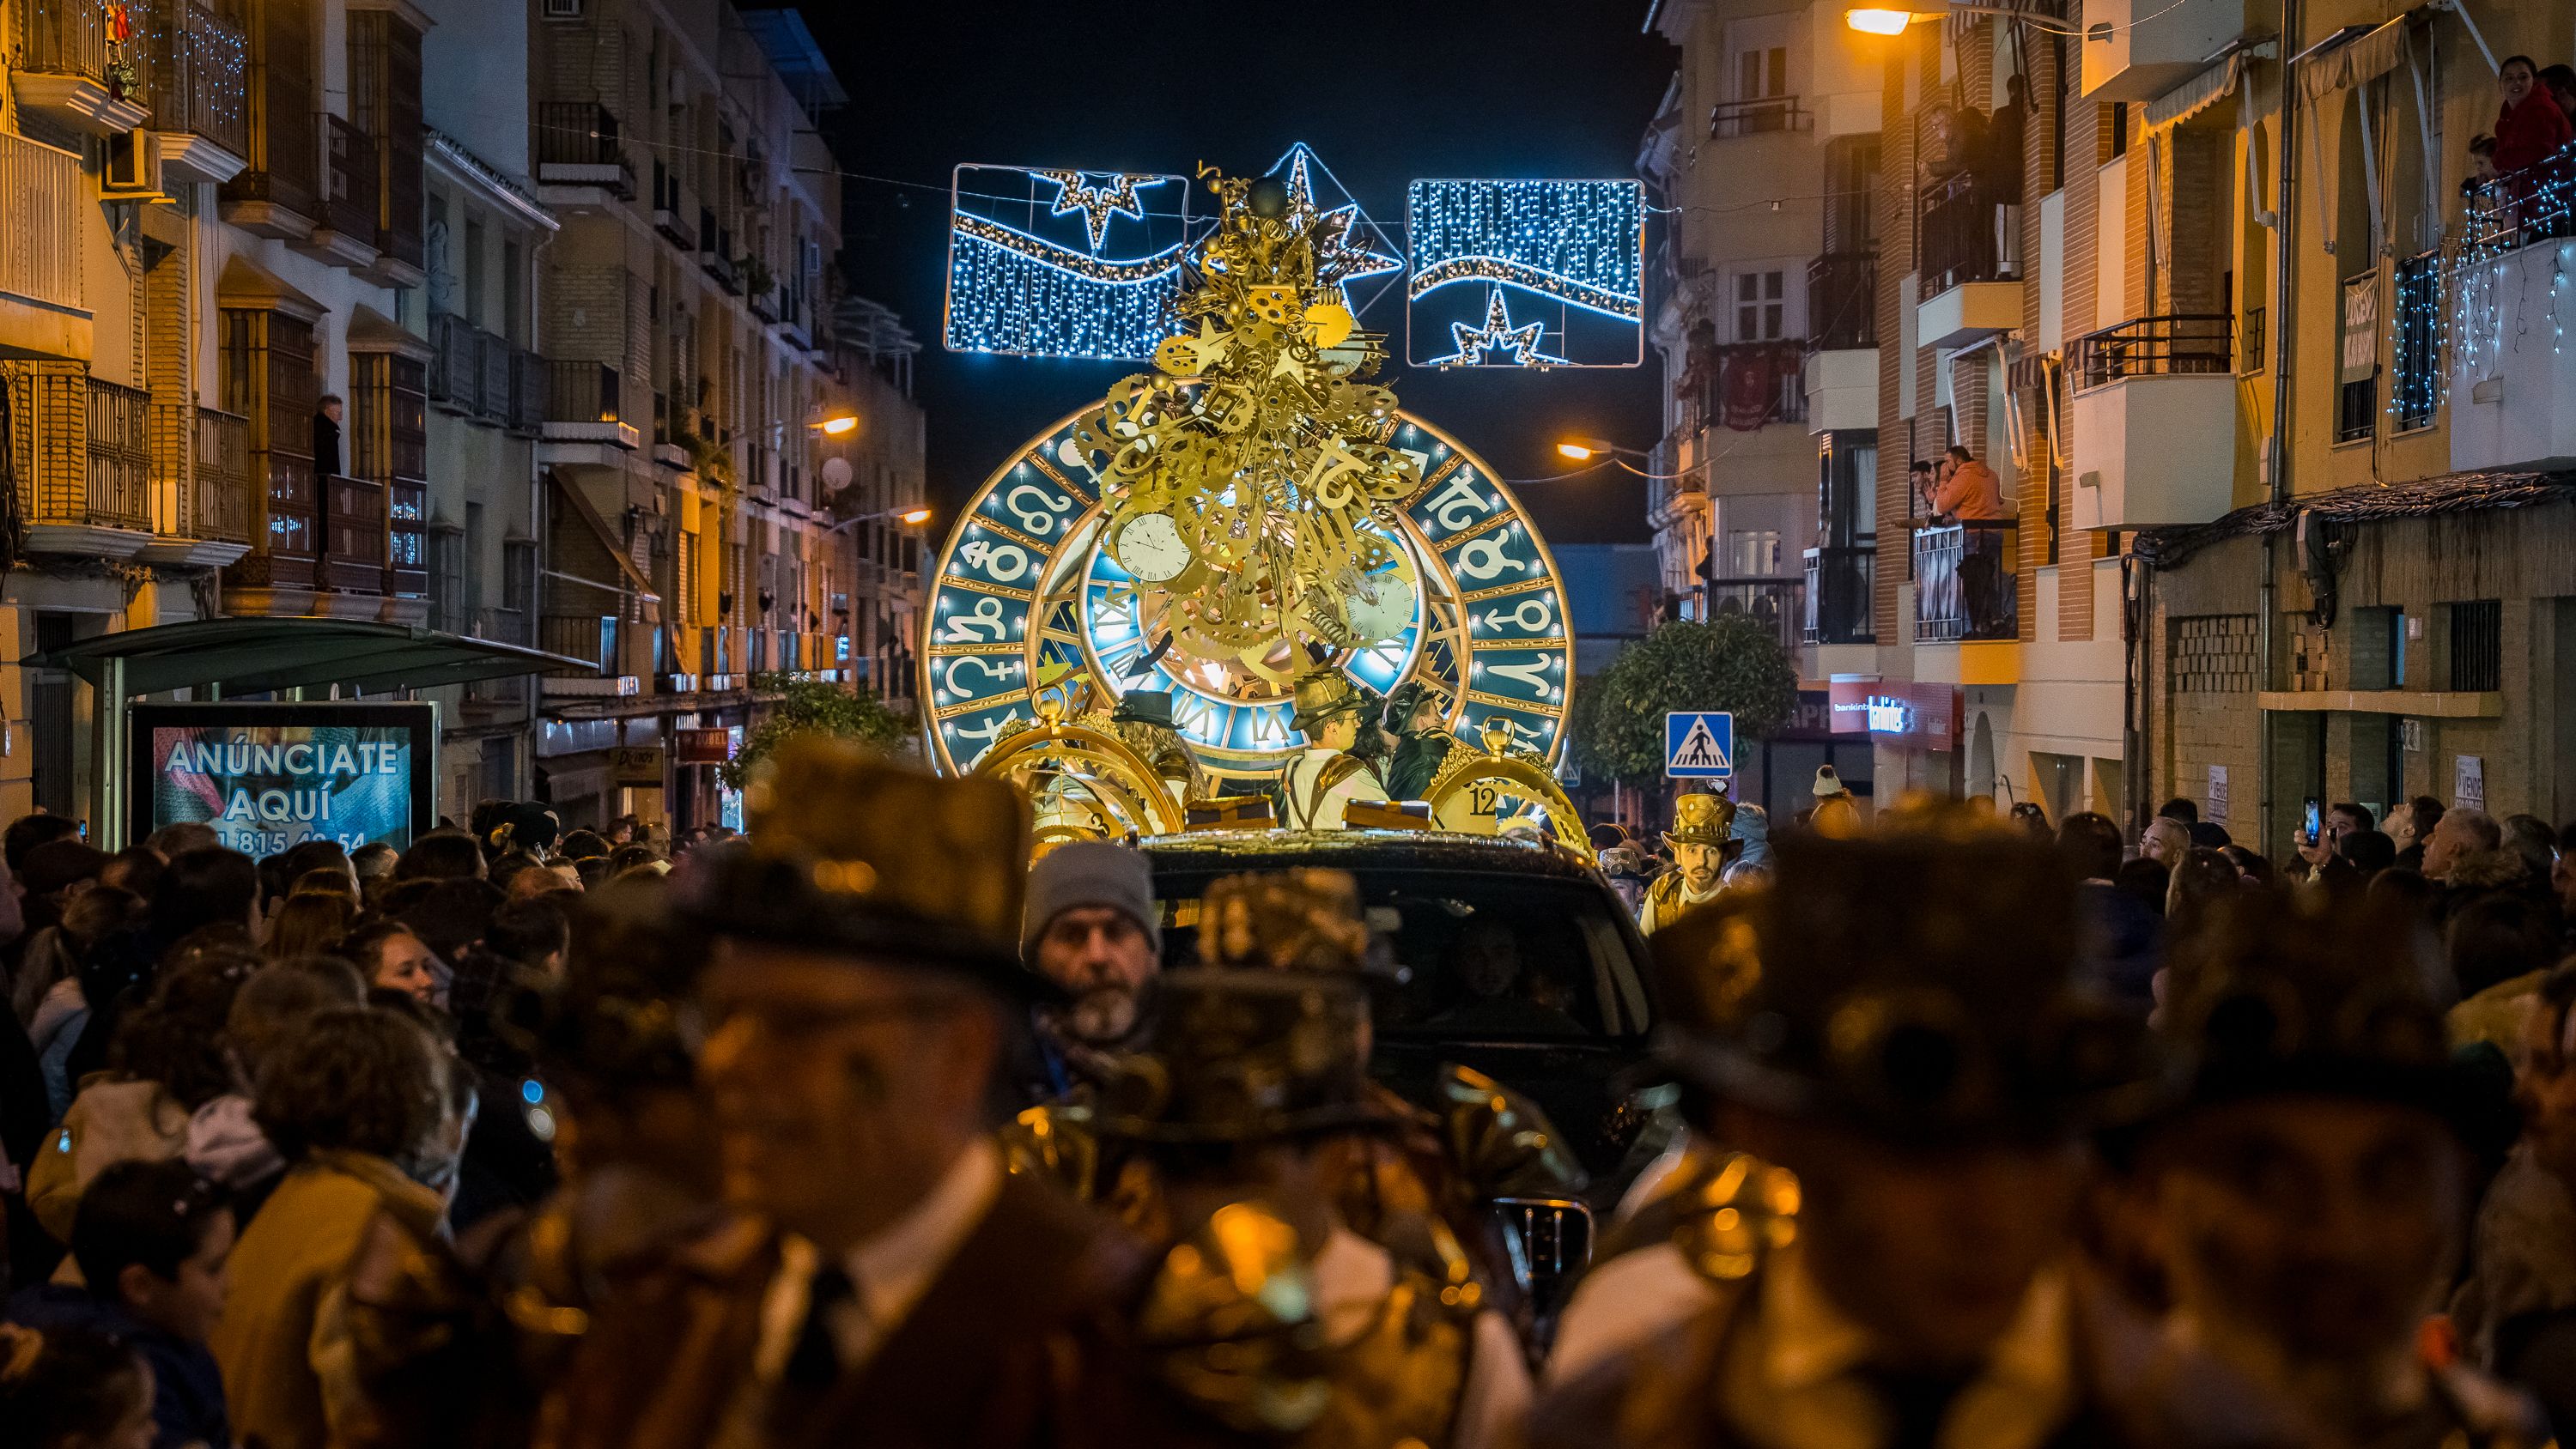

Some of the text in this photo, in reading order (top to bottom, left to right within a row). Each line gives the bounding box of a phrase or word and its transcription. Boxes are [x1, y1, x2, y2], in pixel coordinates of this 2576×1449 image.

[165, 736, 398, 774] ANÚNCIATE
[226, 781, 332, 822] AQUÍ
[1469, 787, 1496, 816] 12
[240, 833, 287, 853] 815
